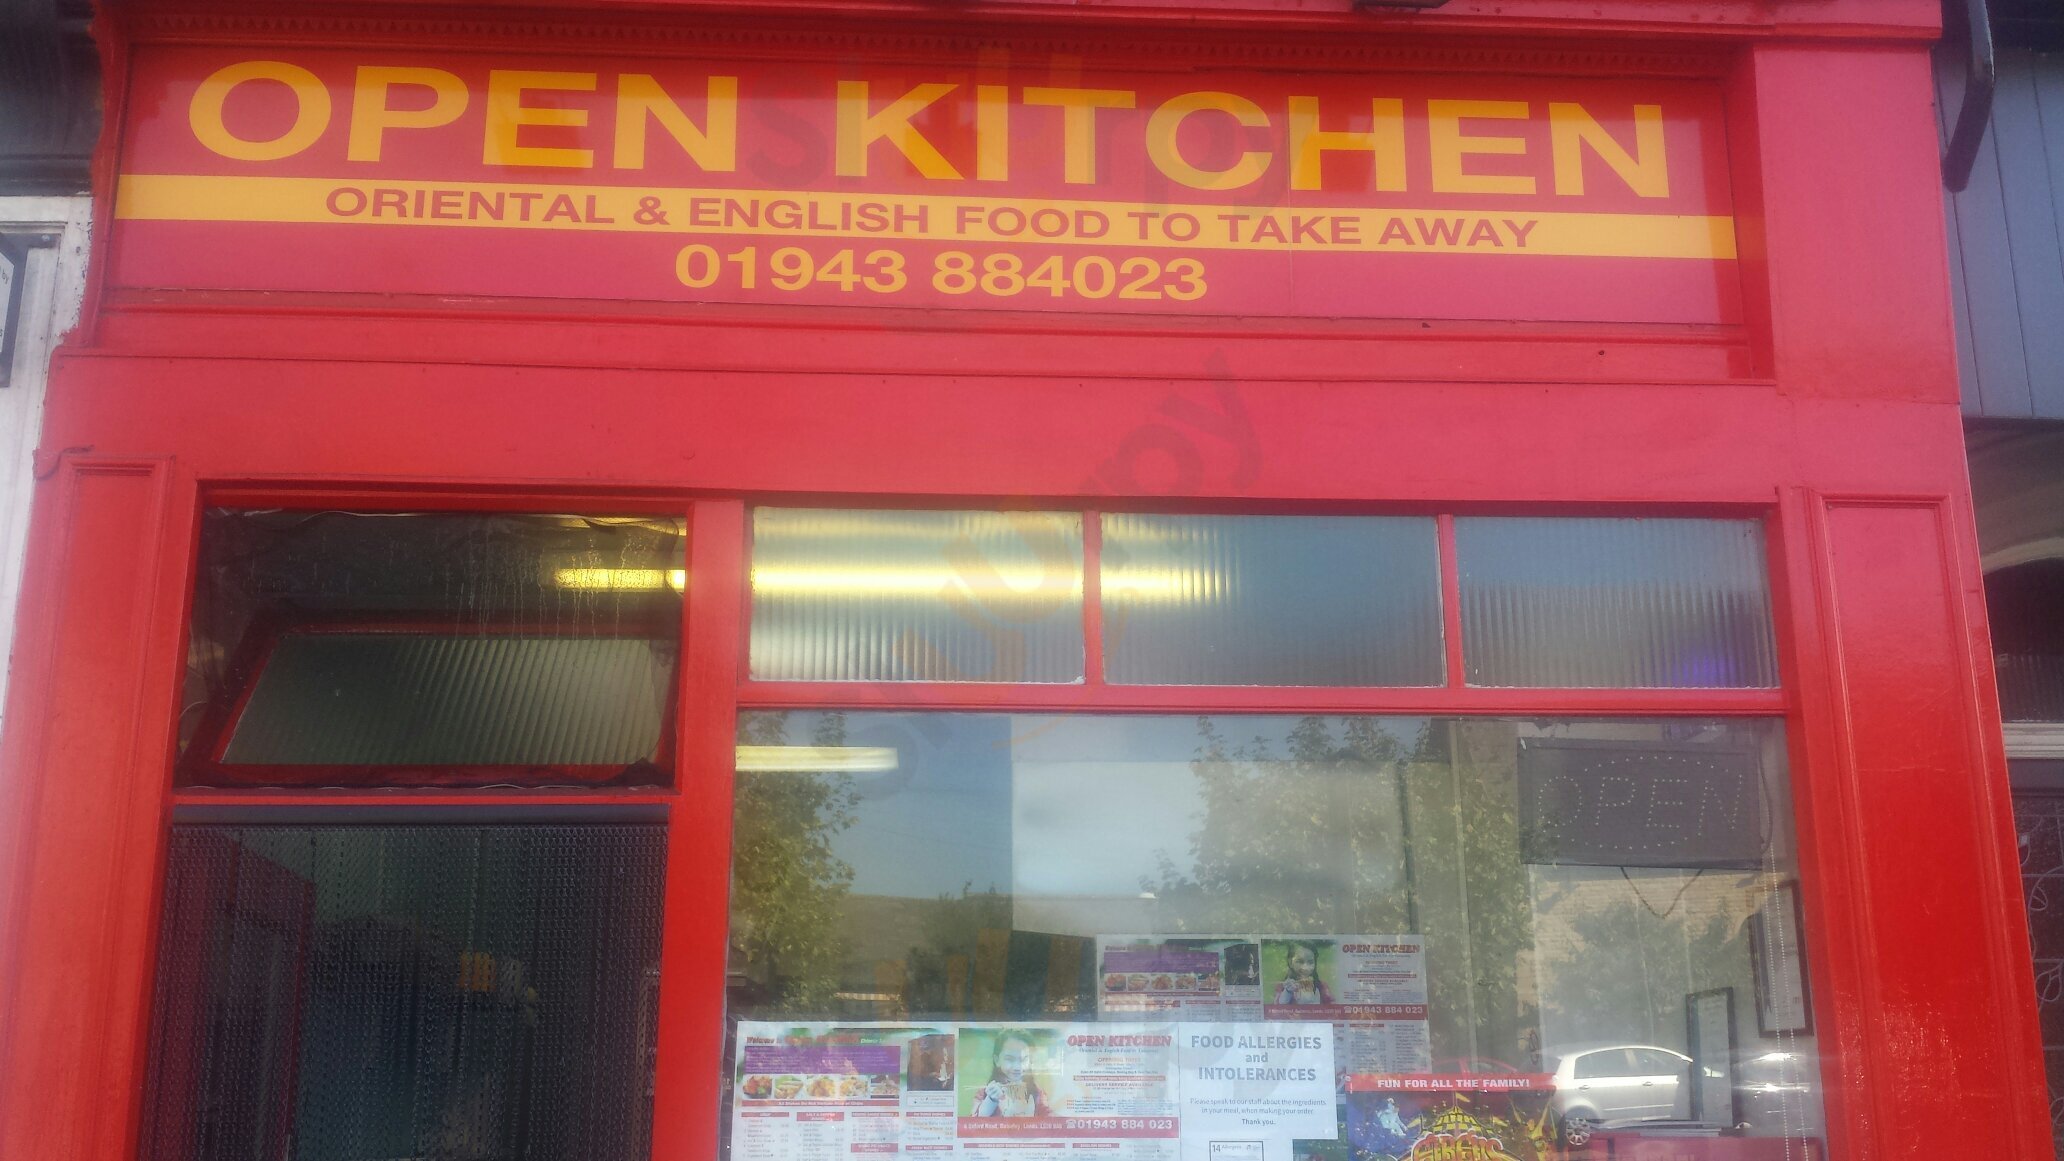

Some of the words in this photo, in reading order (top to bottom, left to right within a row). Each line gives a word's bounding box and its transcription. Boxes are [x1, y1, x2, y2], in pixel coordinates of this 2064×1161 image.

[189, 60, 738, 173] OPEN
[836, 80, 1669, 197] KITCHEN
[326, 186, 615, 225] ORIENTAL
[633, 193, 670, 226] &
[689, 197, 929, 234] ENGLISH
[956, 205, 1110, 241] FOOD
[1128, 211, 1201, 243] TO
[1217, 213, 1362, 246] TAKE
[1376, 216, 1539, 249] AWAY
[676, 245, 907, 292] 01943
[932, 251, 1208, 301] 884023
[1538, 773, 1744, 837] OPEN
[1342, 943, 1371, 954] OPEN
[1372, 943, 1421, 954] KITCHEN
[1352, 1005, 1382, 1015] 01943
[1385, 1006, 1403, 1015] 884
[1405, 1006, 1423, 1015] 023
[1067, 1034, 1106, 1047] OPEN
[1108, 1035, 1173, 1047] KITCHEN
[1191, 1035, 1234, 1049] FOOD
[1237, 1035, 1322, 1050] ALLERGIES
[1245, 1052, 1269, 1063] and
[1198, 1066, 1317, 1081] INTOLERANCES
[1377, 1079, 1401, 1089] FUN
[1404, 1079, 1429, 1089] FOR
[1432, 1079, 1454, 1089] ALL
[1455, 1079, 1479, 1089] THE
[1482, 1079, 1530, 1089] FAMILY!
[1190, 1097, 1211, 1105] Please
[1211, 1098, 1228, 1106] speak
[1258, 1108, 1282, 1116] making
[1077, 1119, 1117, 1130] 01943
[1121, 1119, 1144, 1130] 884
[1149, 1119, 1173, 1130] 023
[1212, 1144, 1221, 1152] 14
